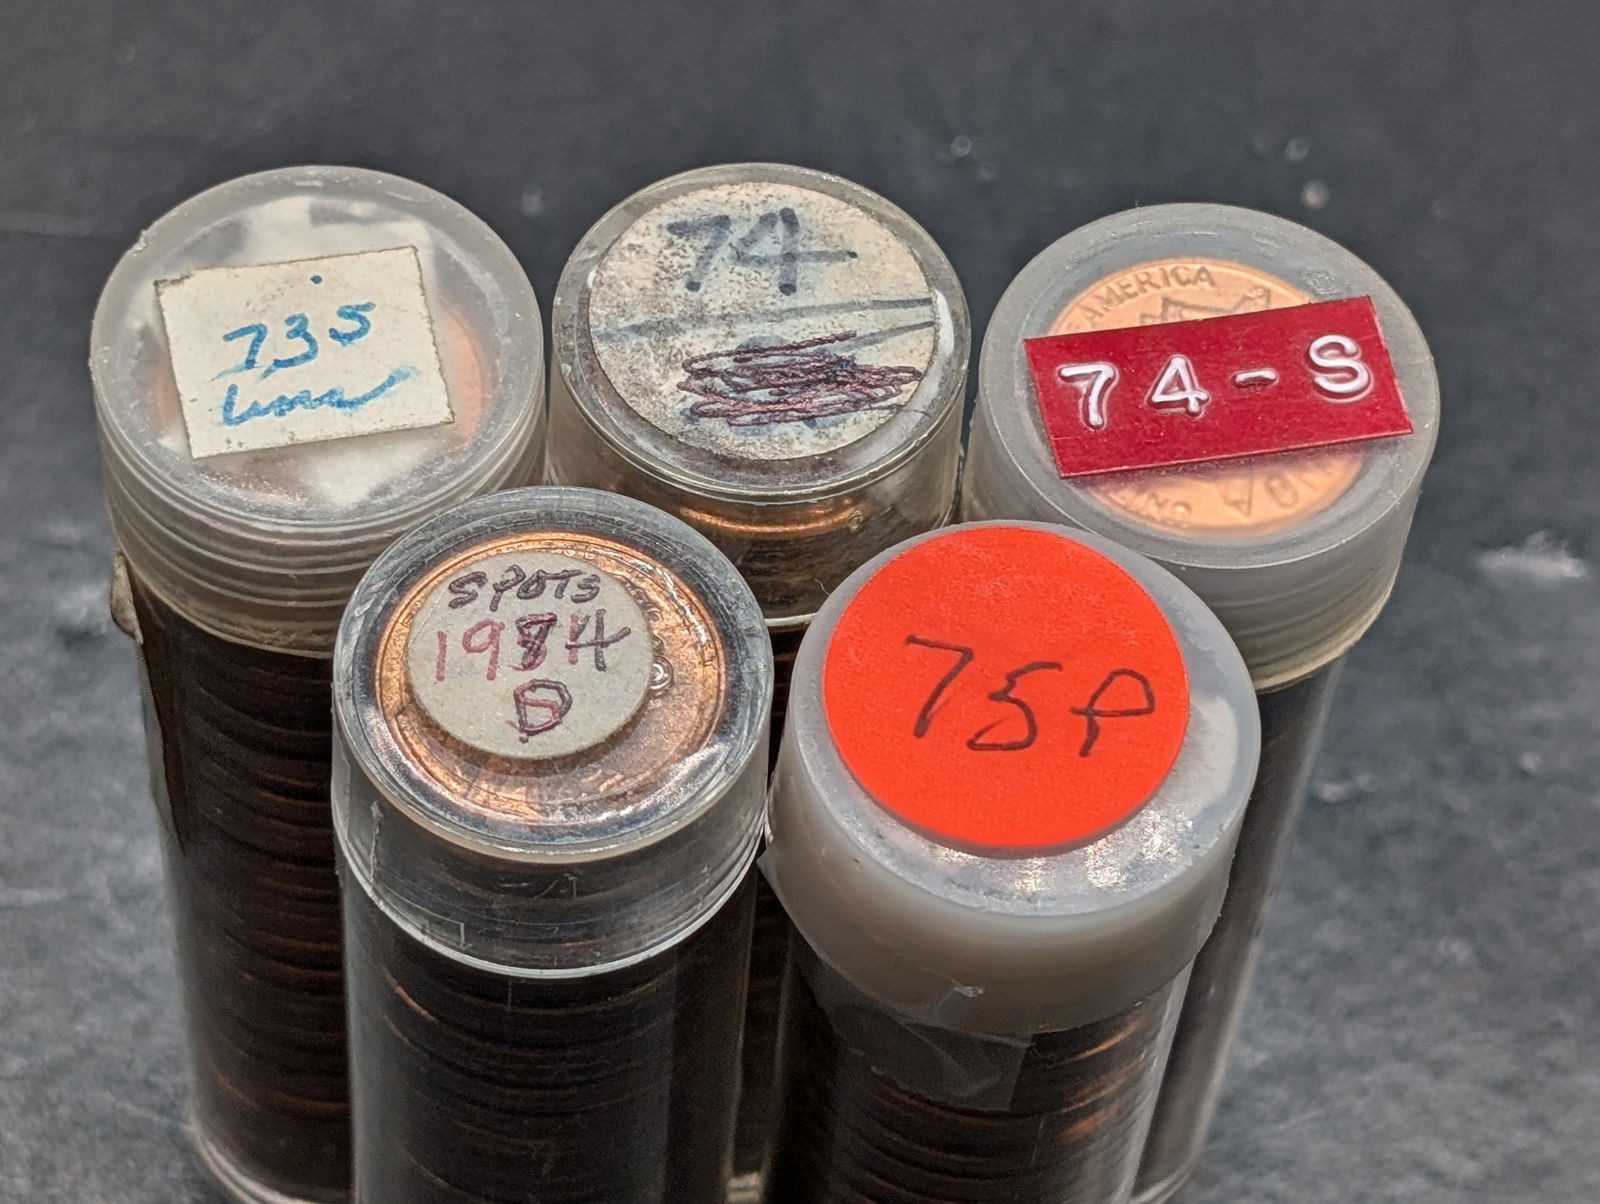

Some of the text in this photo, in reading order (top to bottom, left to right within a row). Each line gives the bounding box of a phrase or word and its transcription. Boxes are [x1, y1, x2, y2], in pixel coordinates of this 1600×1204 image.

[668, 207, 858, 295] 74
[1078, 265, 1217, 331] AMERICA
[906, 634, 1157, 758] 75P
